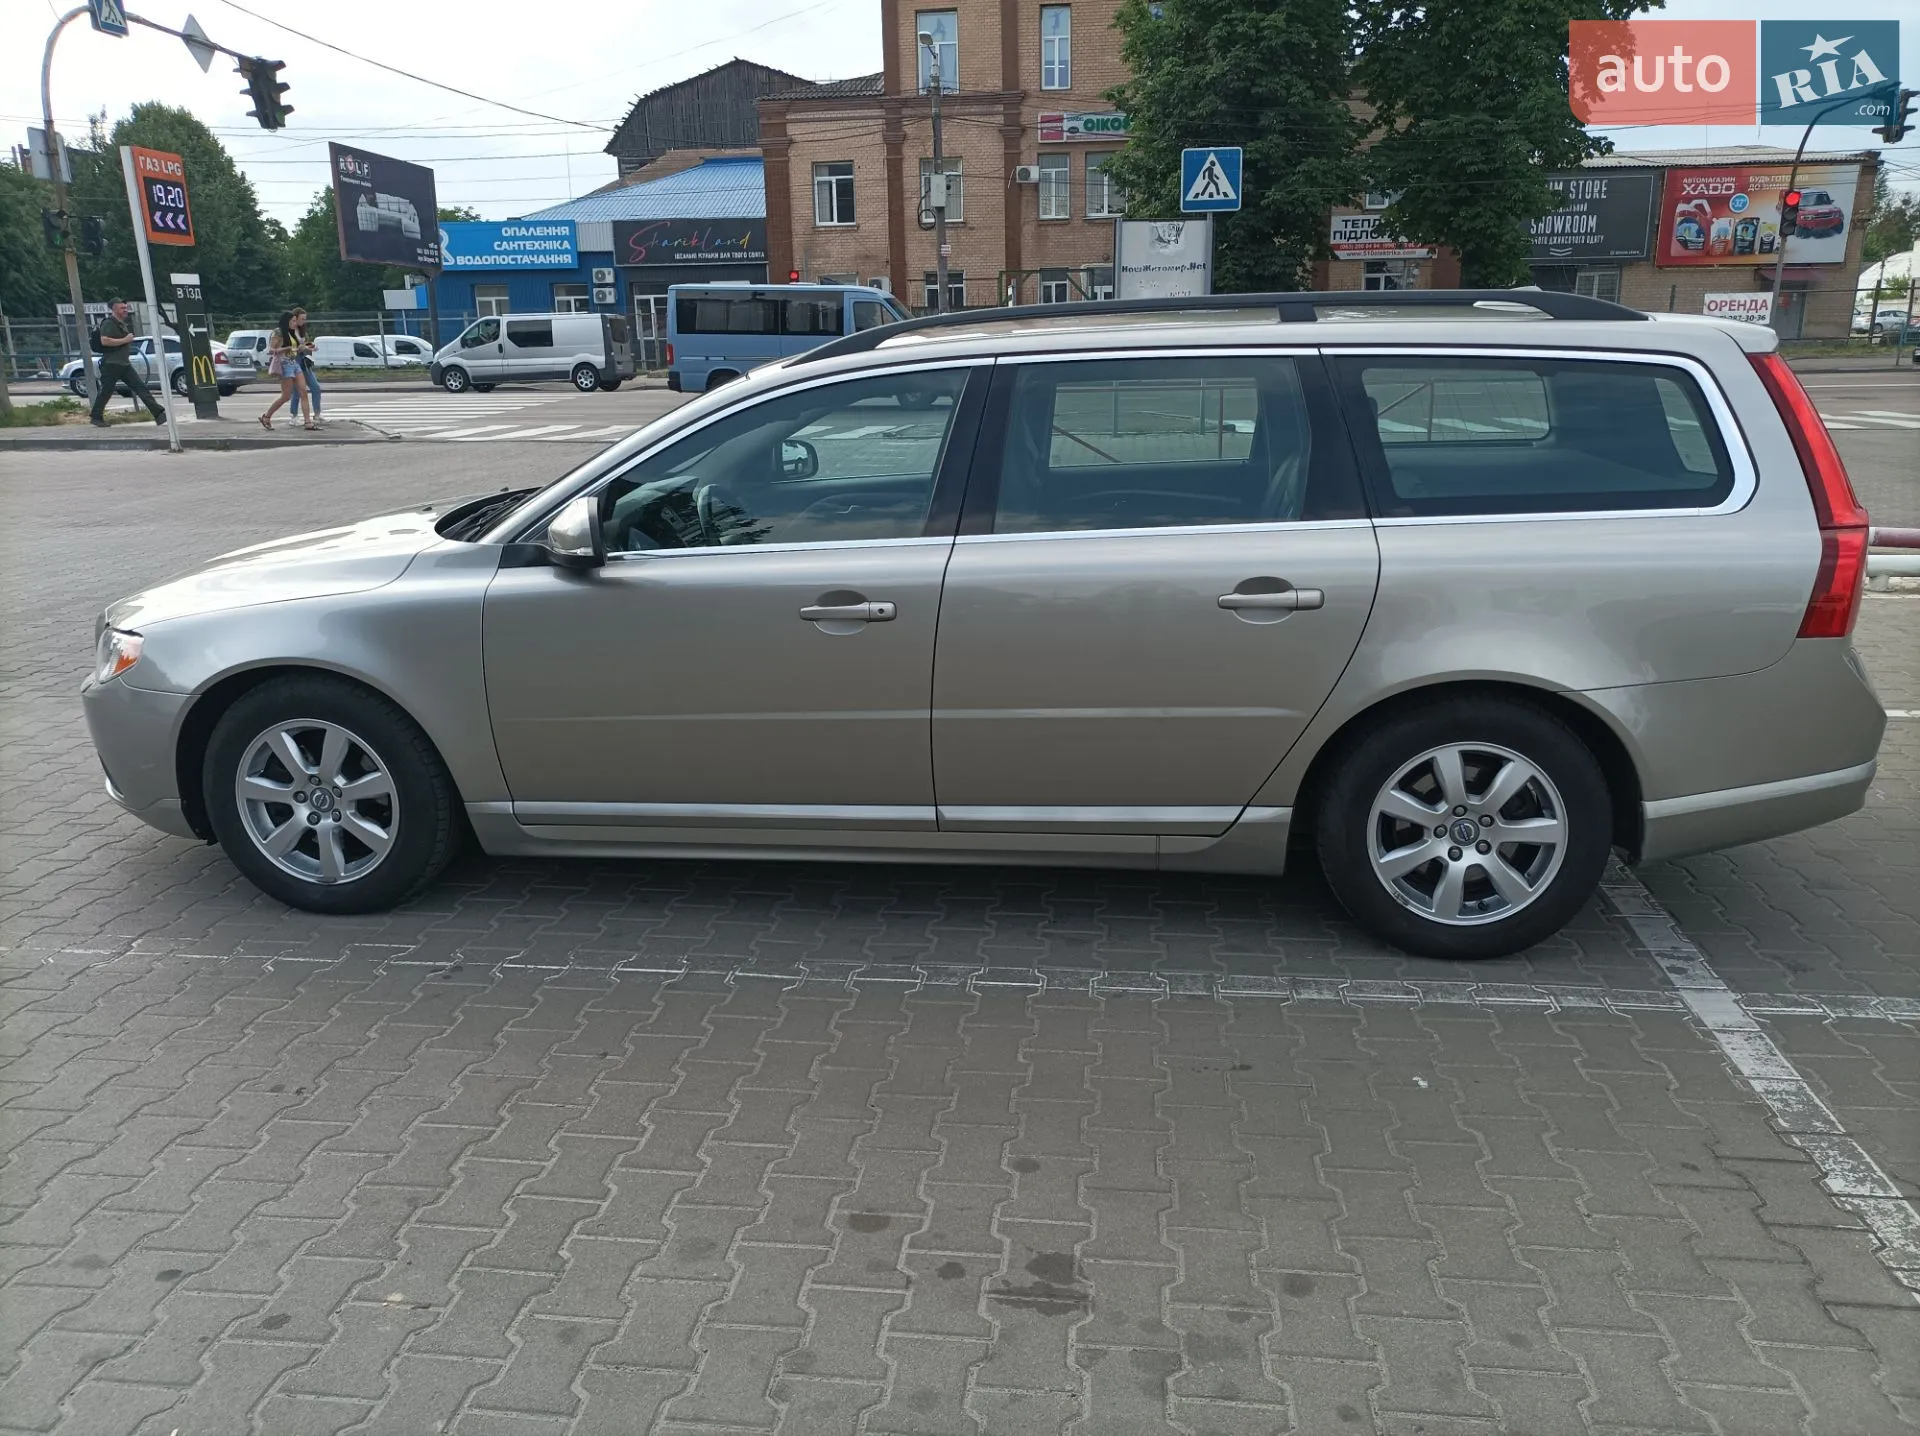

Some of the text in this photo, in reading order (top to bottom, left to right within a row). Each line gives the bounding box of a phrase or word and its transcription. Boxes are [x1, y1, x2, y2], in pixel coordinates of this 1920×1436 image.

[138, 155, 182, 177] ГАЗ LPG
[339, 156, 370, 177] ROLF
[1682, 176, 1736, 184] АВТОМАГАЗИН
[152, 184, 185, 208] 19.20
[1569, 179, 1609, 200] STORE
[1681, 183, 1736, 196] XADO
[501, 226, 570, 237] ОПАЛЕННЯ
[1530, 214, 1597, 235] SHOWROOM
[493, 240, 571, 251] САНТЕХНІКА
[456, 254, 572, 265] ВОДОПОСТАЧАННЯ
[1707, 298, 1769, 314] ОРЕНДА
